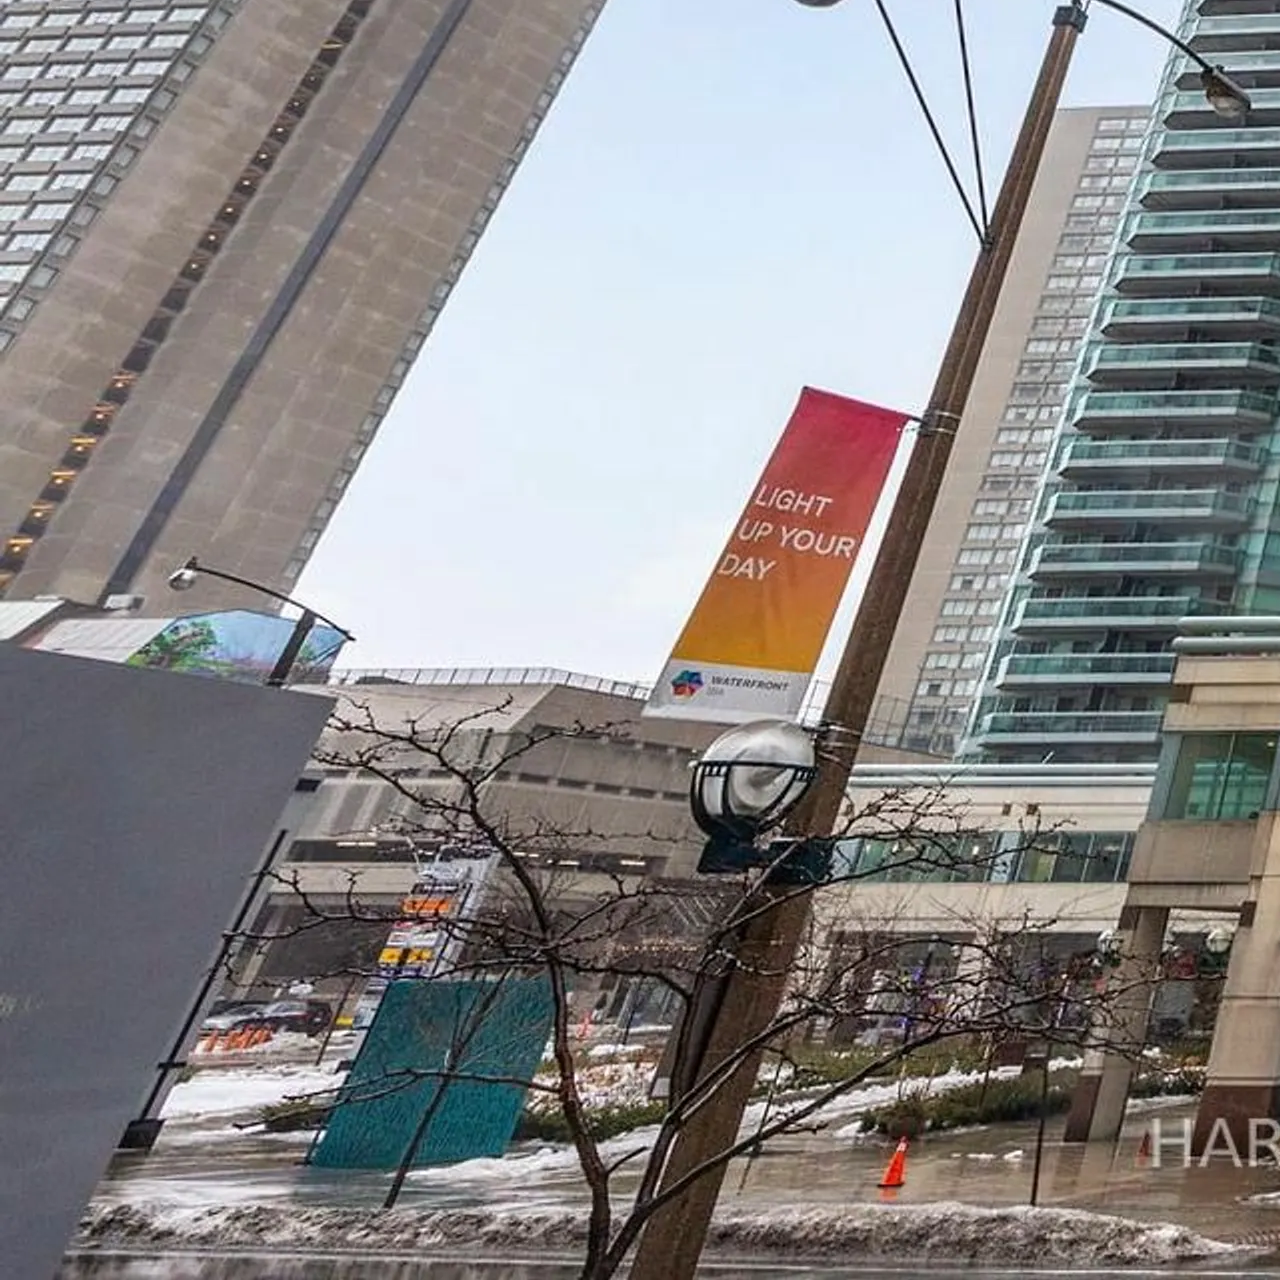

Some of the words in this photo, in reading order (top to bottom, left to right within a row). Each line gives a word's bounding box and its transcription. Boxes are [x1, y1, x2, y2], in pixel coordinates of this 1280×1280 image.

[756, 486, 832, 517] LIGHT
[739, 520, 772, 540] UP
[780, 527, 855, 557] YOUR
[719, 555, 776, 579] DAY
[711, 675, 788, 690] WATERFRONT
